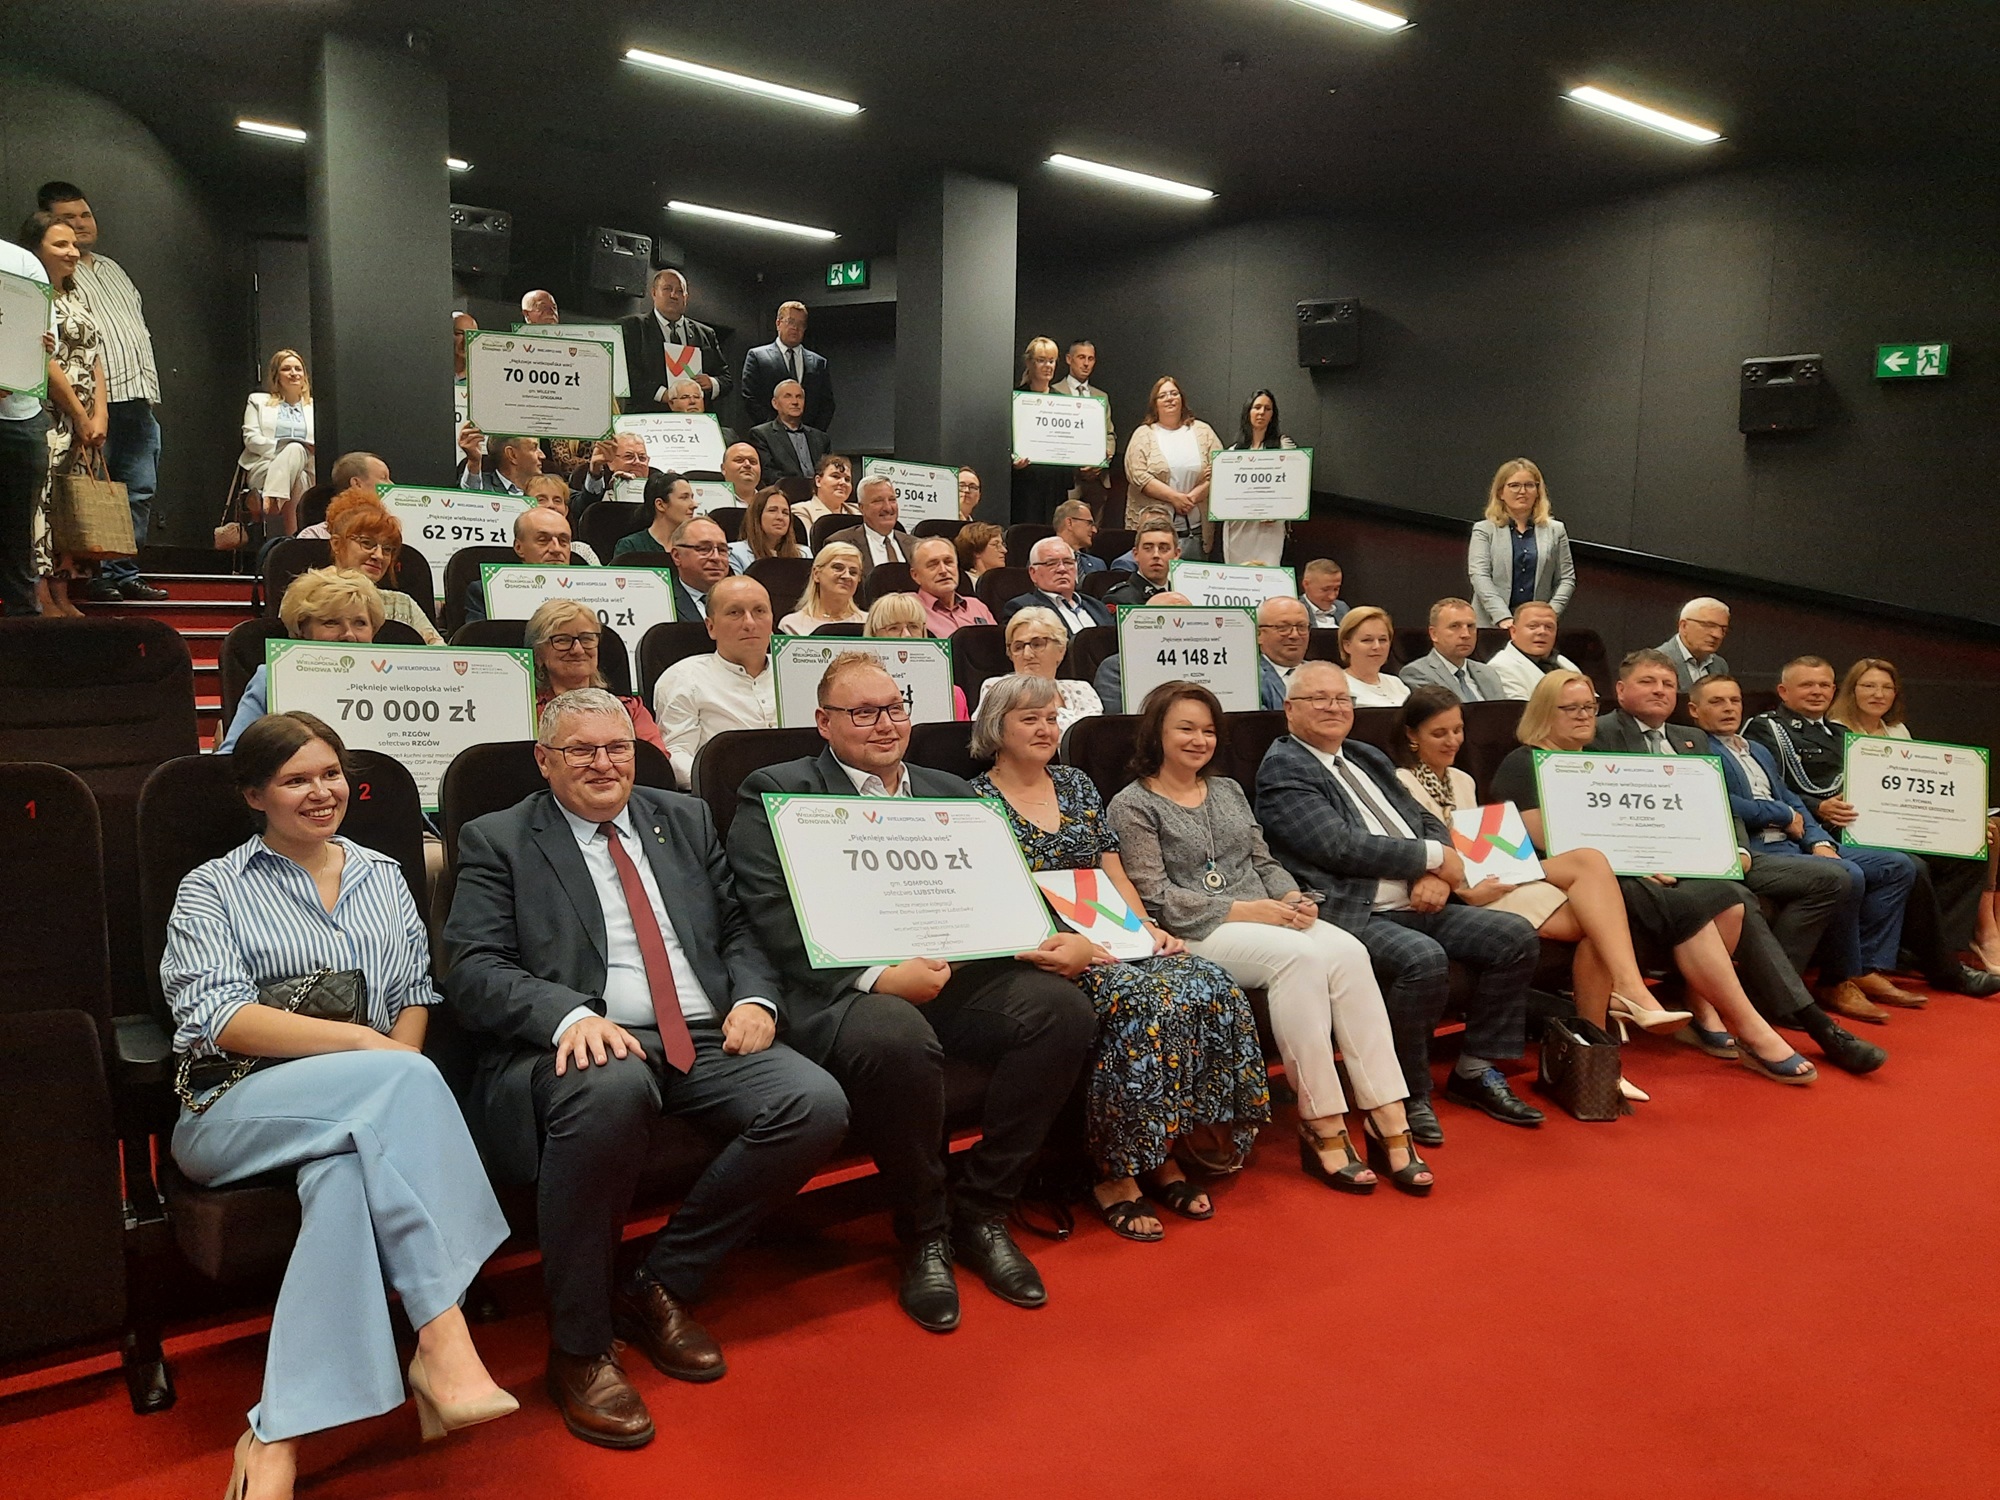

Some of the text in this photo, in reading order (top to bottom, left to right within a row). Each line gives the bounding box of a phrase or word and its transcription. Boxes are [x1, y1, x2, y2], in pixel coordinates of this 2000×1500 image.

[503, 367, 580, 387] 70 000 zł
[1035, 416, 1084, 429] 70 000 zł
[663, 434, 685, 443] 062
[688, 433, 700, 443] zł
[1234, 472, 1286, 483] 70 000 zł
[904, 489, 924, 501] 504
[927, 491, 937, 503] zł
[422, 524, 507, 543] 62 975 zł
[1203, 593, 1220, 607] 70
[1224, 595, 1251, 607] 000
[615, 607, 635, 626] zł
[136, 642, 146, 656] 1
[1156, 646, 1228, 666] 44 148 zł
[389, 684, 442, 693] wielkopolska
[336, 698, 476, 722] 70 000 zł
[358, 783, 372, 800] 2
[1881, 775, 1955, 797] 69 735 zł
[25, 800, 36, 819] 1
[1586, 791, 1683, 811] 39 476 zł
[885, 834, 933, 842] wielkopolska
[843, 847, 973, 871] 70 000 zł
[903, 879, 944, 887] SOMPOLNO
